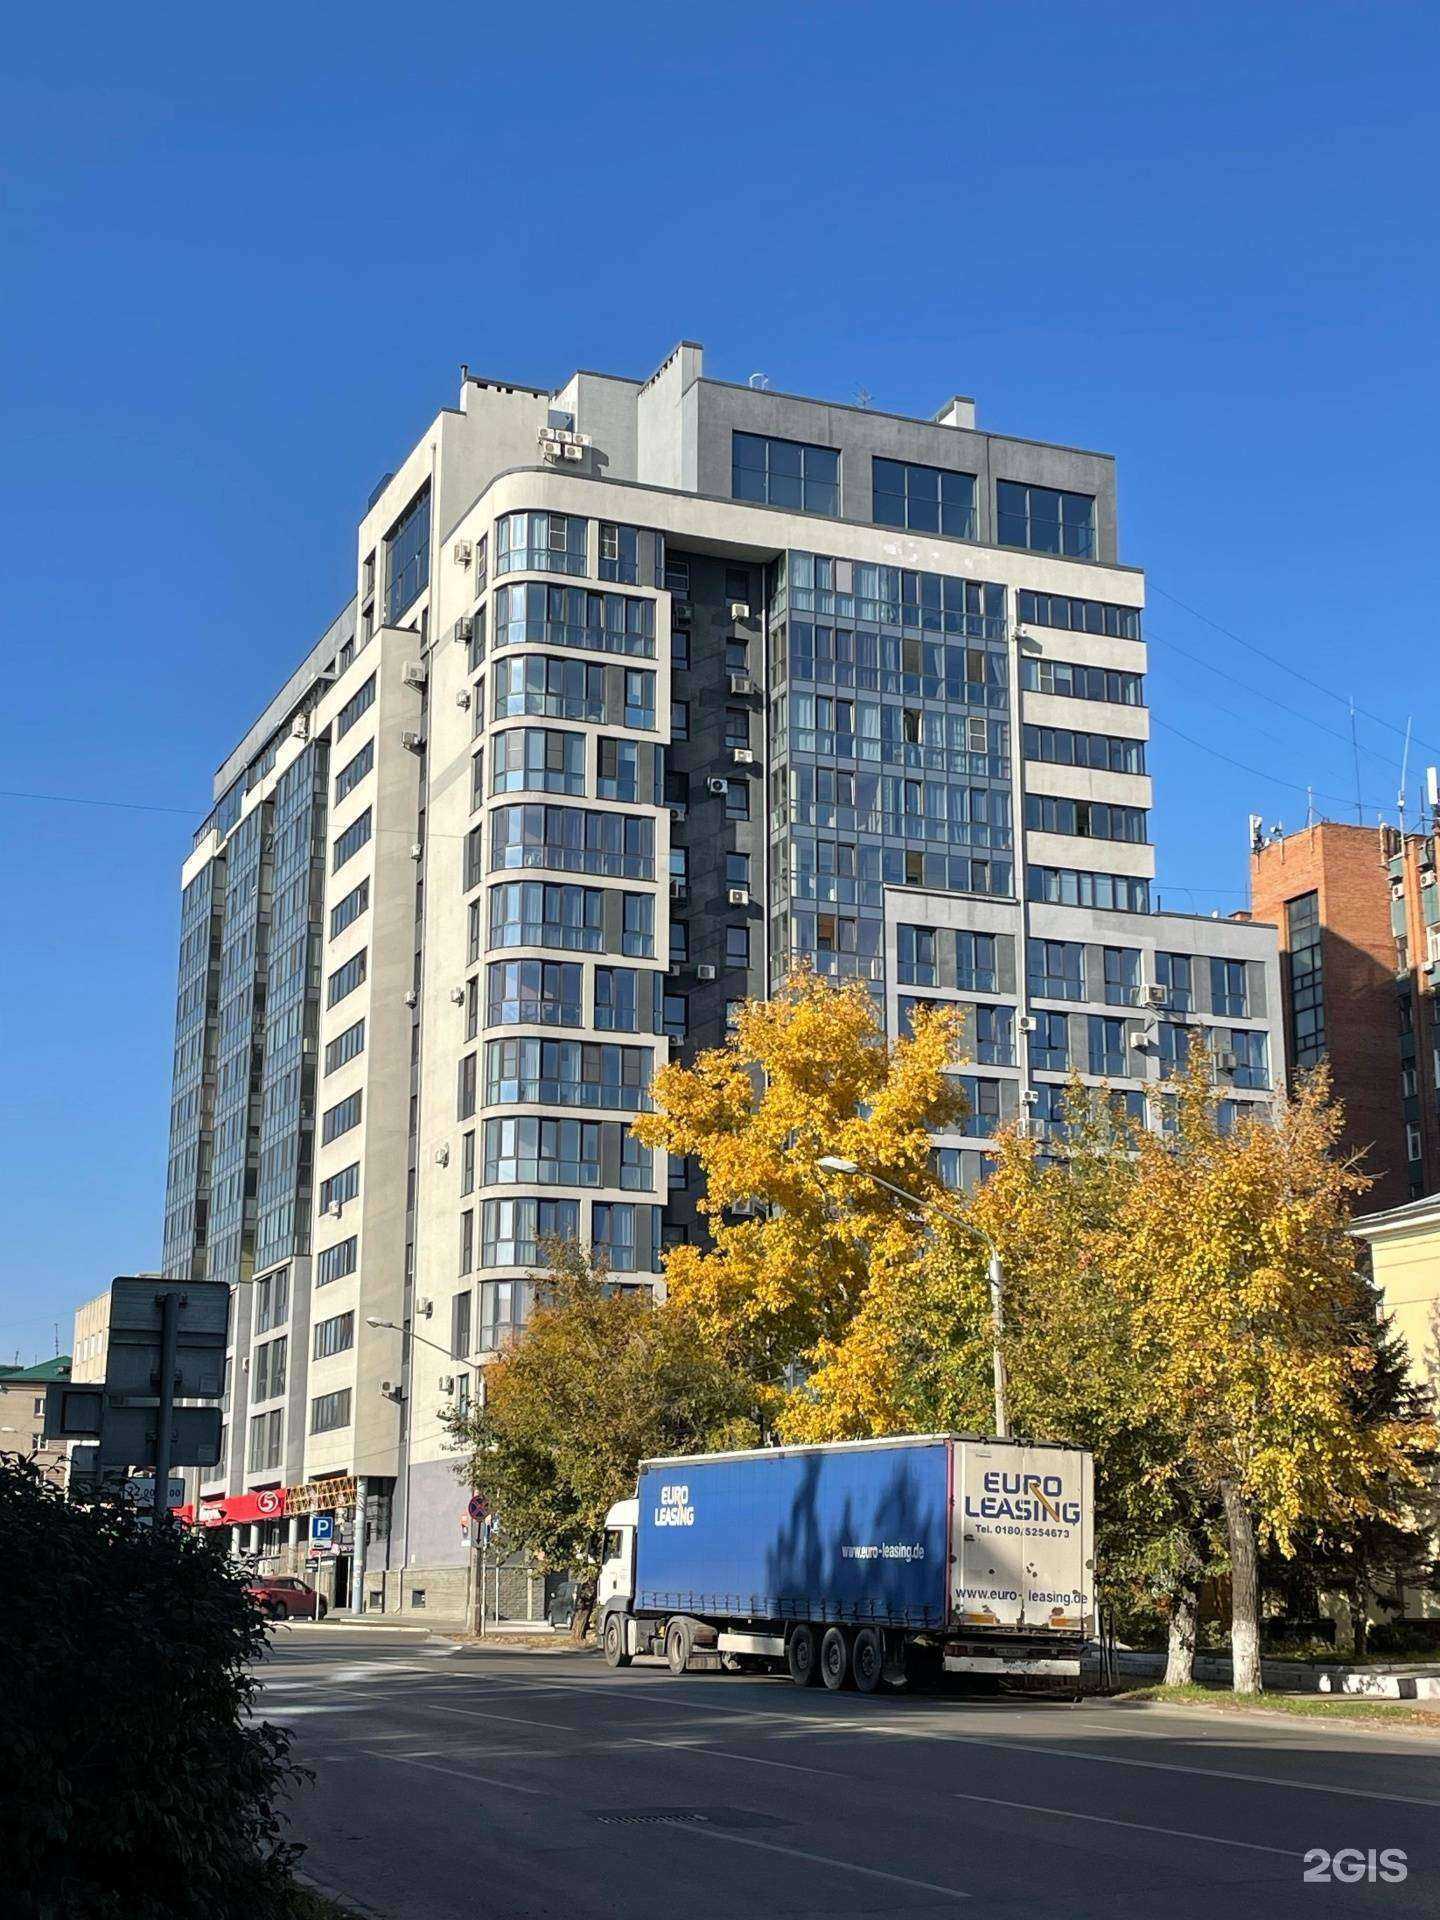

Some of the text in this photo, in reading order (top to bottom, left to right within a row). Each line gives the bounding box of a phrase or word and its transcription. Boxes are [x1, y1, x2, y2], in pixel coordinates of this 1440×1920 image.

[984, 1472, 1062, 1497] EURO
[661, 1485, 688, 1505] EURO
[654, 1506, 694, 1526] LEASING
[965, 1496, 1081, 1526] LEASING
[317, 1519, 329, 1536] P
[975, 1524, 992, 1534] Tel.
[841, 1542, 925, 1563] www.euro-leasing.de
